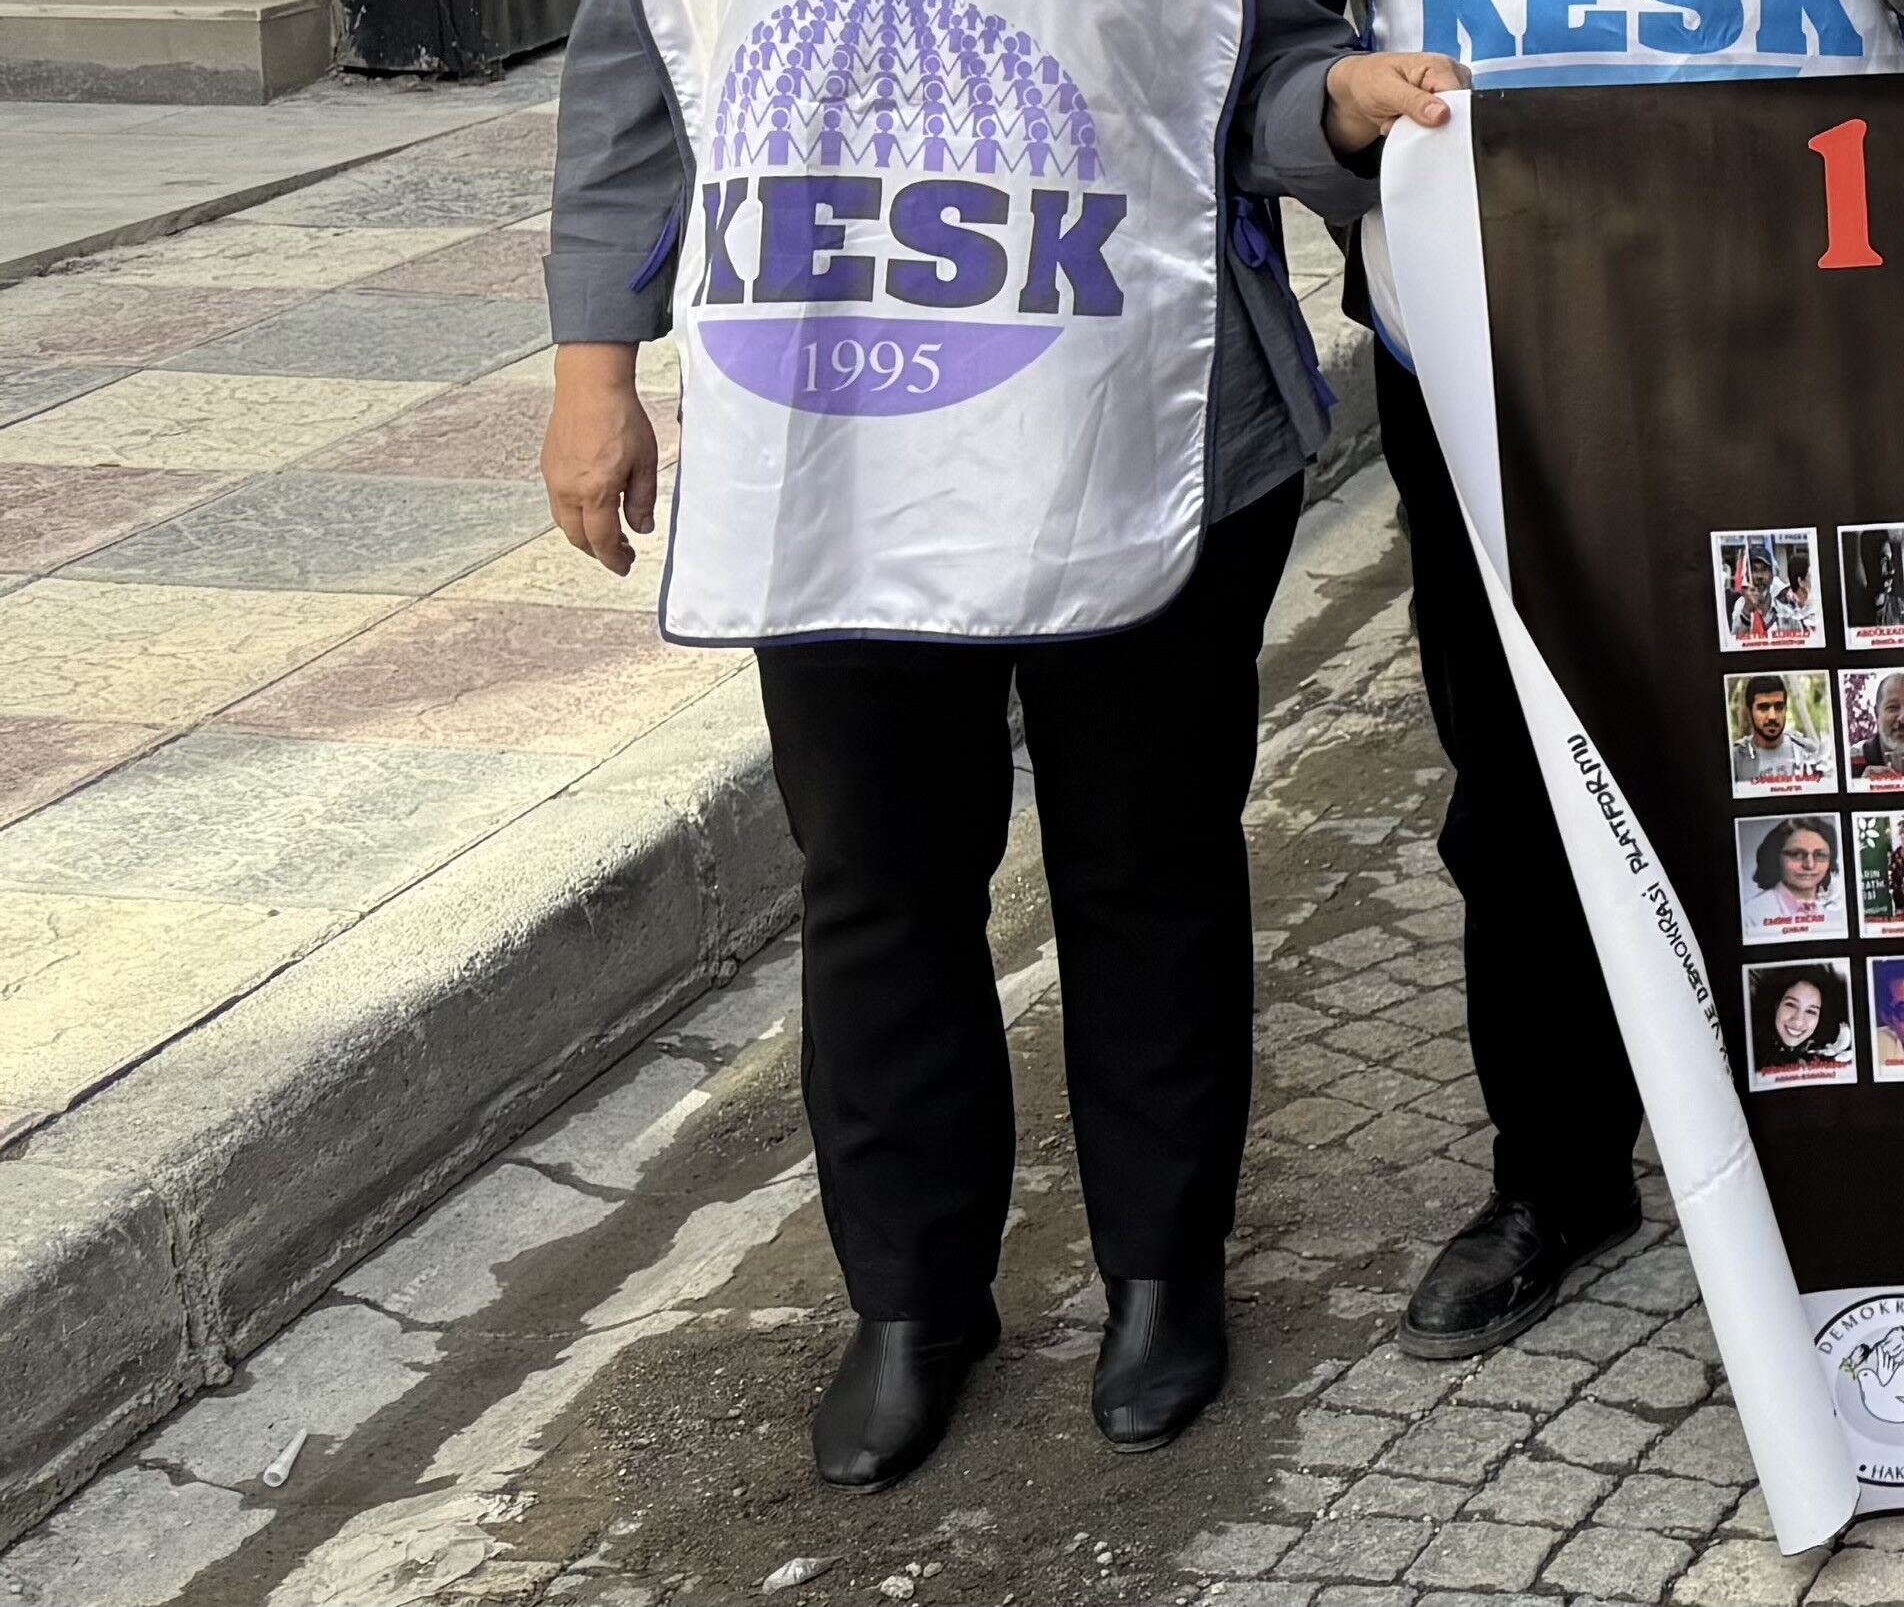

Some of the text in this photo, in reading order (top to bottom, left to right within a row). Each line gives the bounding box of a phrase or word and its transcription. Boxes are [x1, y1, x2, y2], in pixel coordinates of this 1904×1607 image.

[691, 175, 1128, 317] KESK
[801, 339, 944, 394] 1995
[1567, 732, 1650, 875] PLATFORMU
